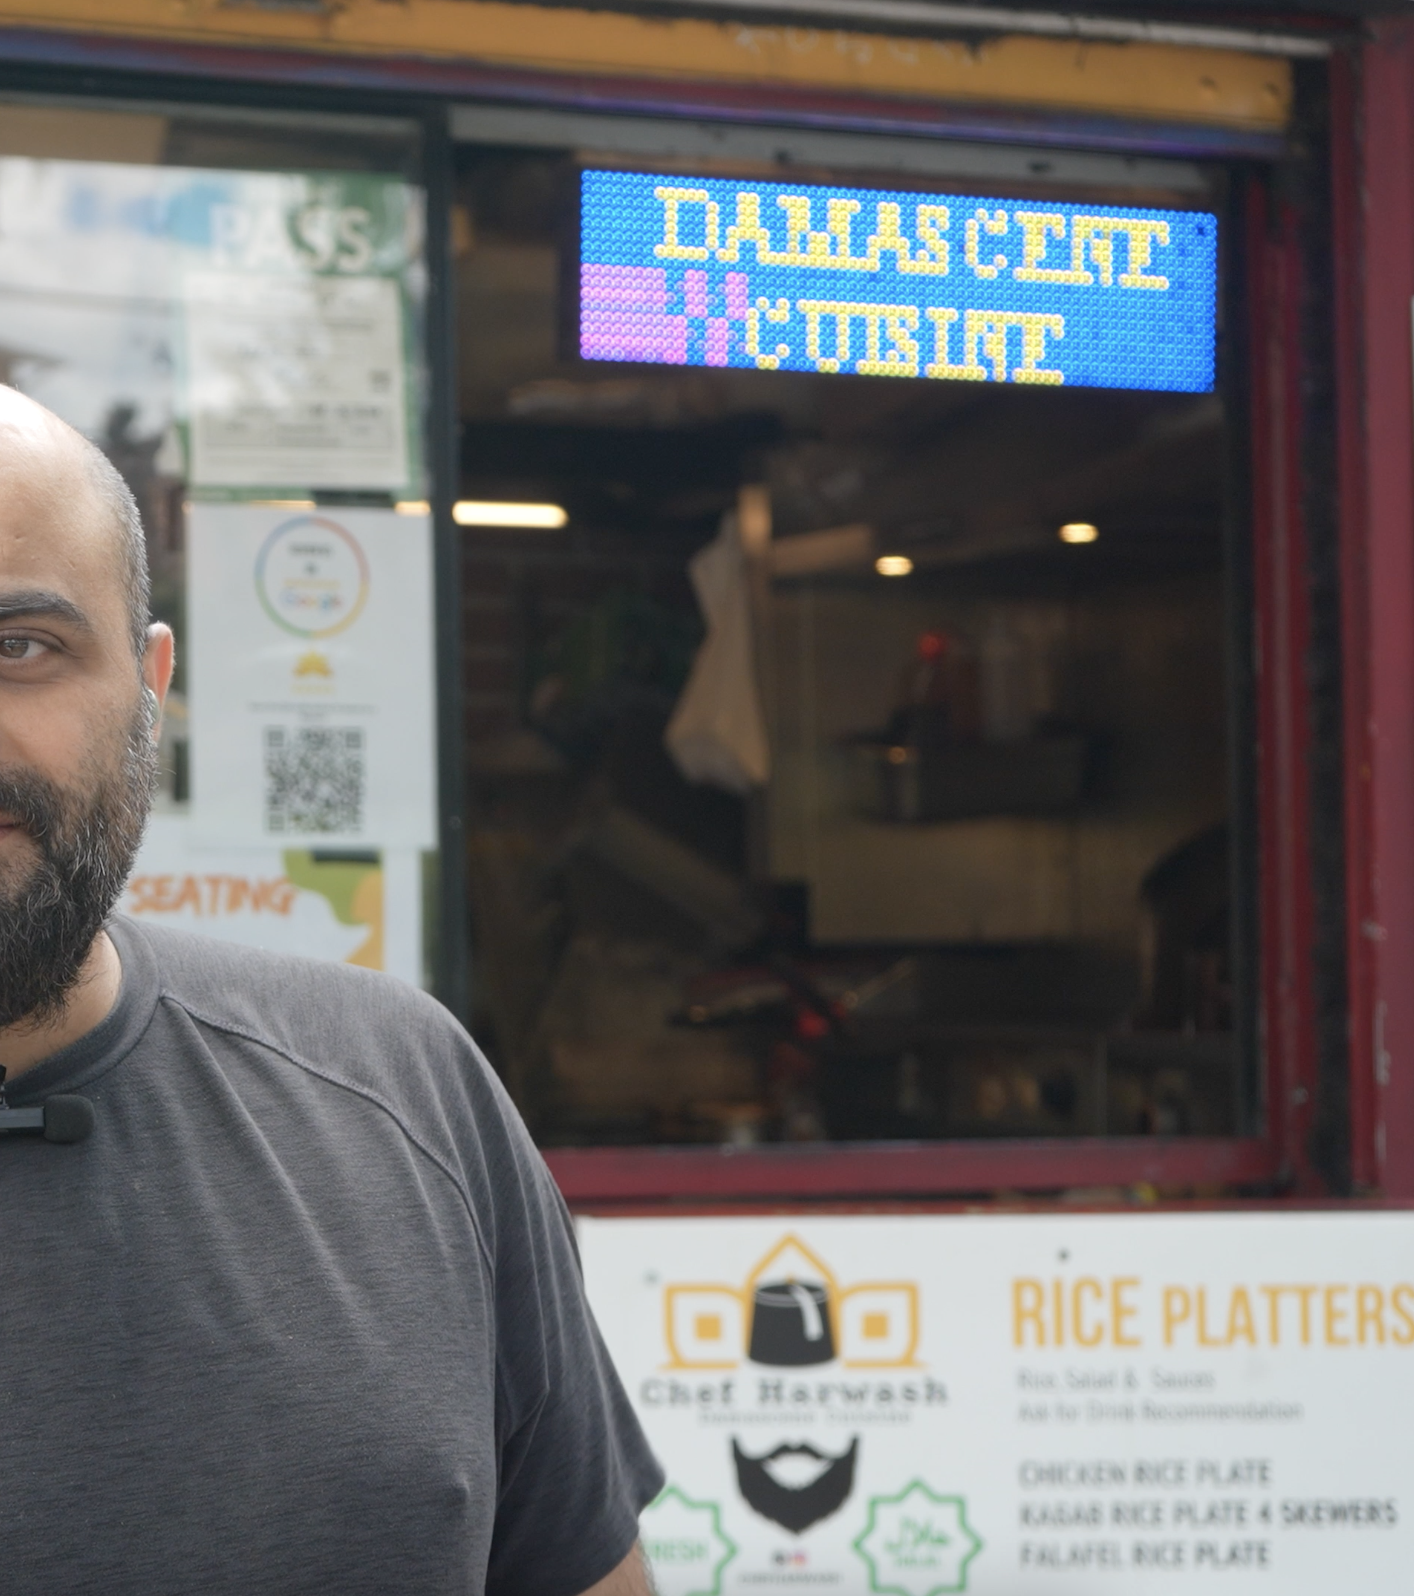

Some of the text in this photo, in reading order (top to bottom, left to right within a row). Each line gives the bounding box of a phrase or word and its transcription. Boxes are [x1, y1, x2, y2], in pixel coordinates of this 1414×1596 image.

[209, 204, 371, 272] PASS
[745, 296, 1065, 385] CUISINE
[129, 873, 297, 918] SEATING
[1011, 1276, 1414, 1348] RICE PLATTERS
[639, 1377, 948, 1408] Chef Harwash
[1018, 1459, 1273, 1488] CHICKEN RICE PLATE
[1109, 1500, 1164, 1528] RICE
[1171, 1500, 1248, 1528] PLATE
[1279, 1500, 1400, 1528] SKEWERS
[1018, 1541, 1273, 1571] FALAFEL RICE PLATE
